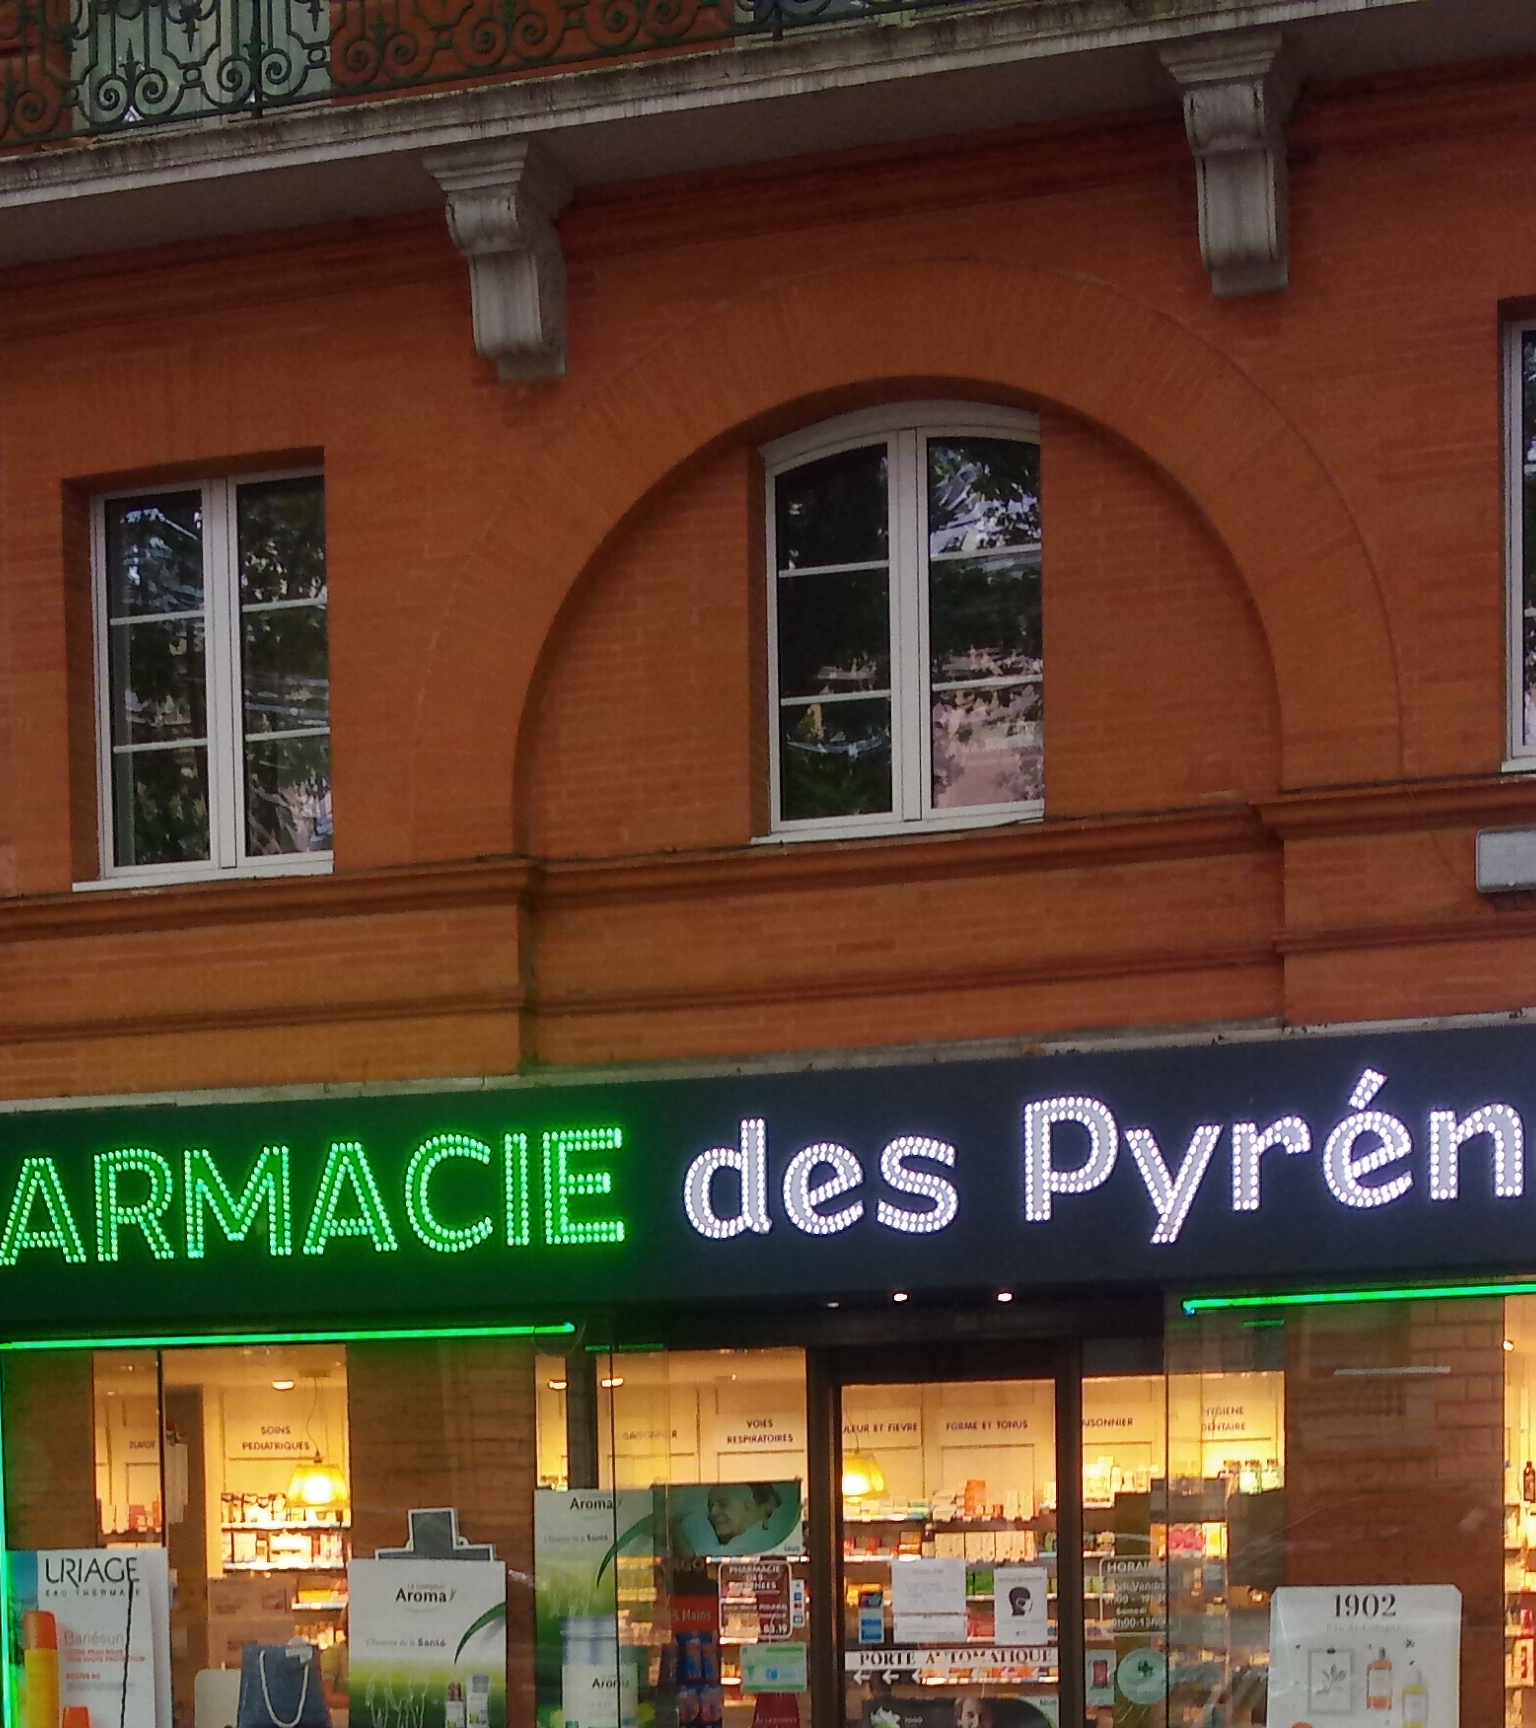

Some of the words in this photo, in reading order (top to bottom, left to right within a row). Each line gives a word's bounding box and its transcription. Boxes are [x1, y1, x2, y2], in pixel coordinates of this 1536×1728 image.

[682, 1115, 961, 1240] des
[746, 1418, 774, 1429] VOIES
[873, 1423, 884, 1433] ET
[887, 1421, 918, 1432] FIEVRE
[945, 1420, 979, 1431] FORME
[981, 1420, 992, 1430] ET
[996, 1419, 1028, 1430] TONUS
[260, 1425, 292, 1436] SOINS
[726, 1433, 794, 1445] RESPIRATOIRES
[241, 1440, 311, 1451] PEDIATRIQUES
[569, 1497, 615, 1511] Aroma
[44, 1556, 141, 1588] URIAGE
[44, 1588, 68, 1598] EAU
[75, 1586, 141, 1598] THERMAE
[394, 1586, 448, 1603] Aroma
[1333, 1593, 1397, 1618] 1902
[417, 1637, 447, 1648] Santé
[859, 1650, 917, 1666] PORTE
